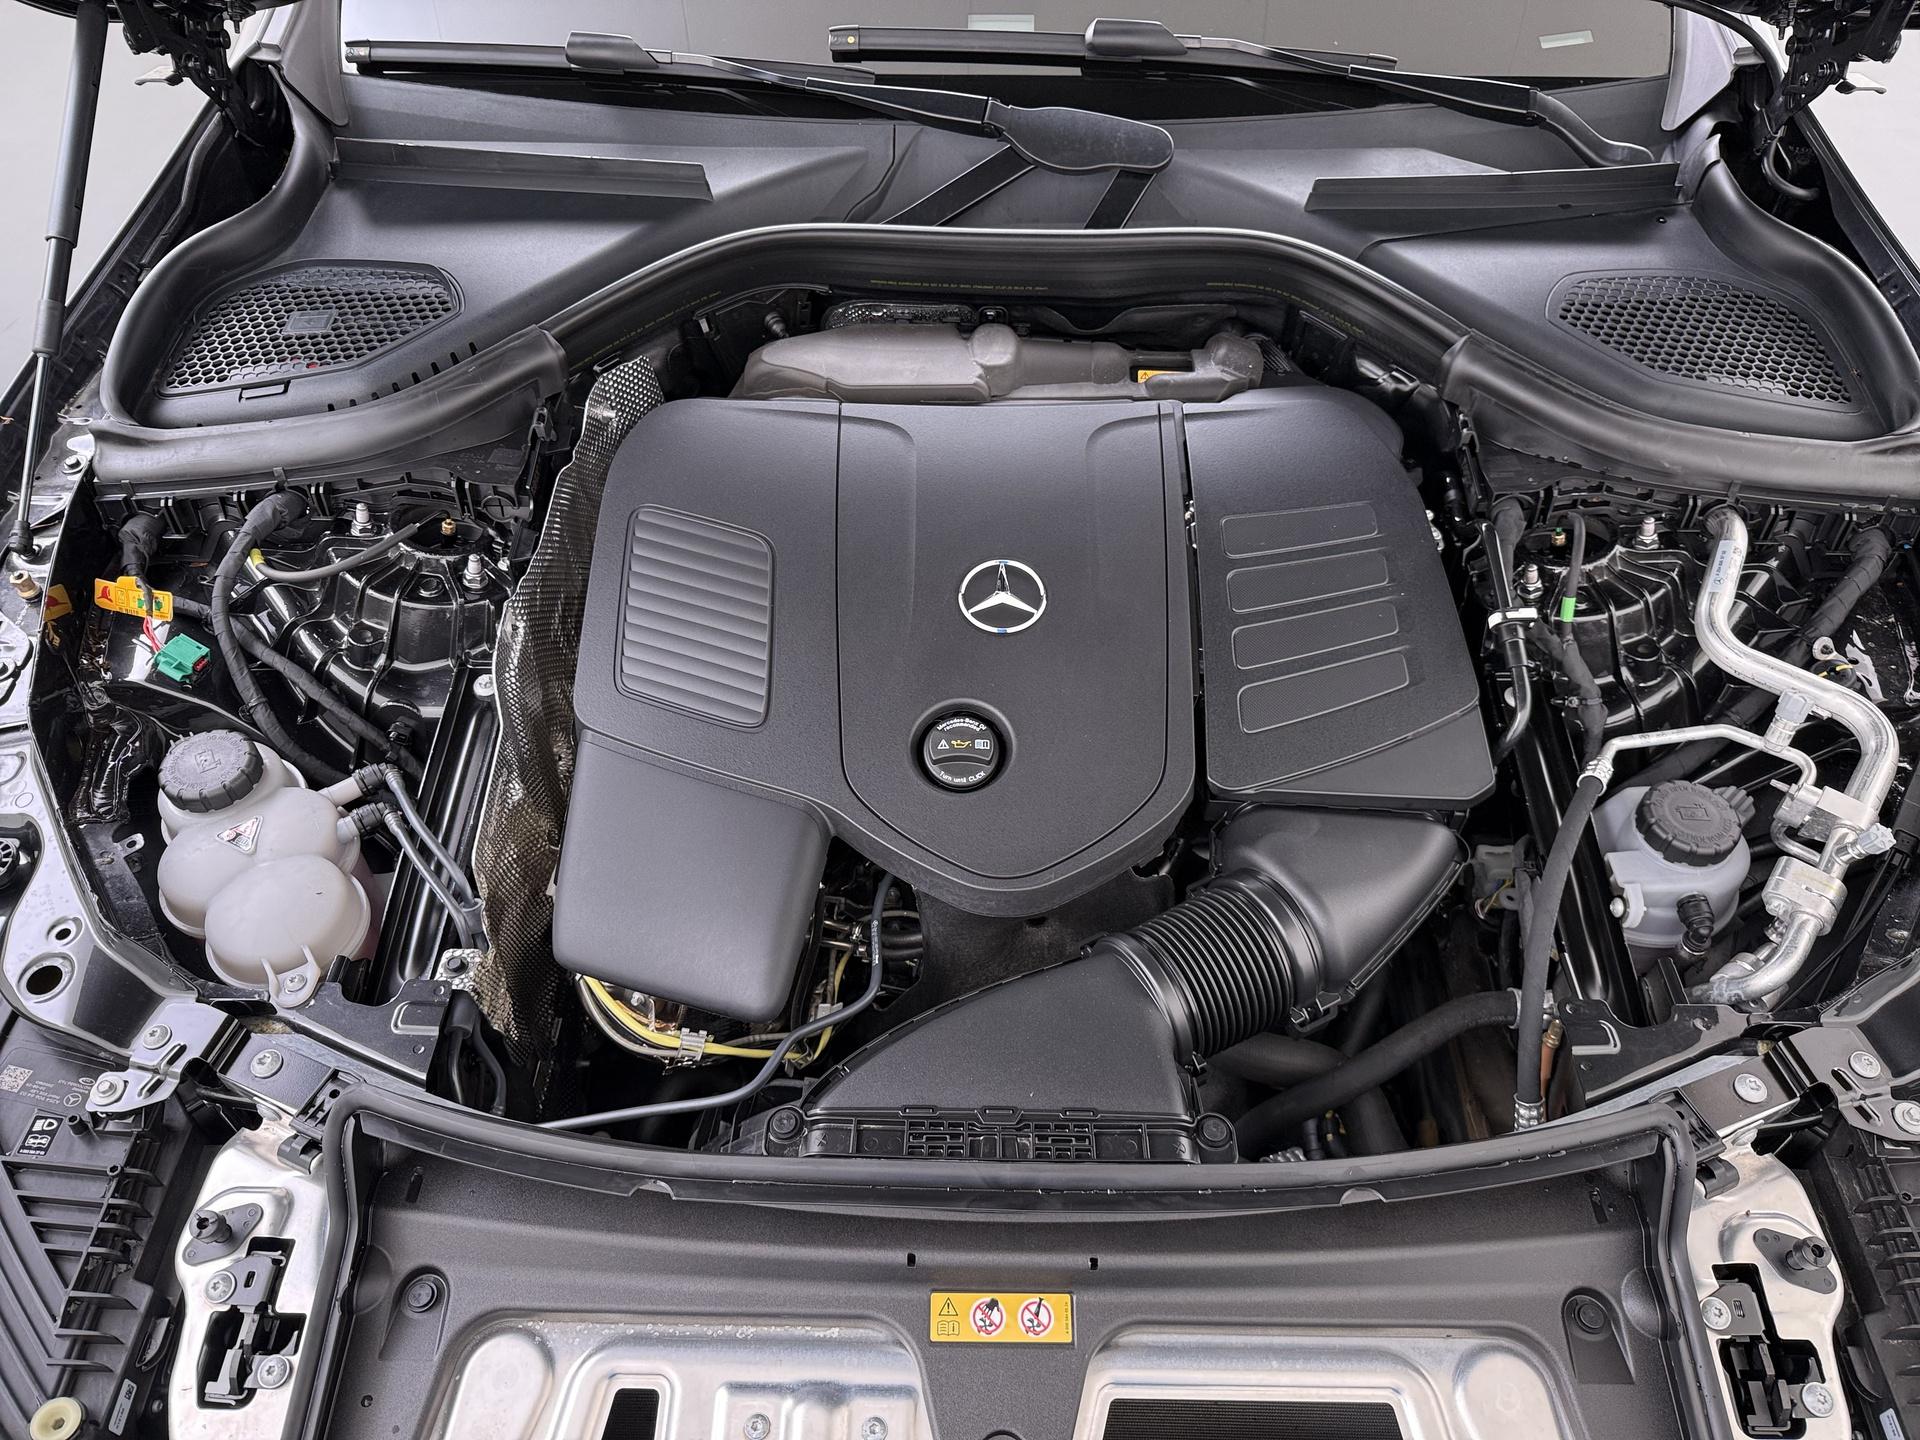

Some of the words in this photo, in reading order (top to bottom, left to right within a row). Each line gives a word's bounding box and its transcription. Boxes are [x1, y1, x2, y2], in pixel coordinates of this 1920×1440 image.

[937, 718, 980, 731] Mercedes-Benz
[943, 722, 981, 732] recommended
[940, 770, 952, 781] Turn
[968, 771, 986, 782] CLICK
